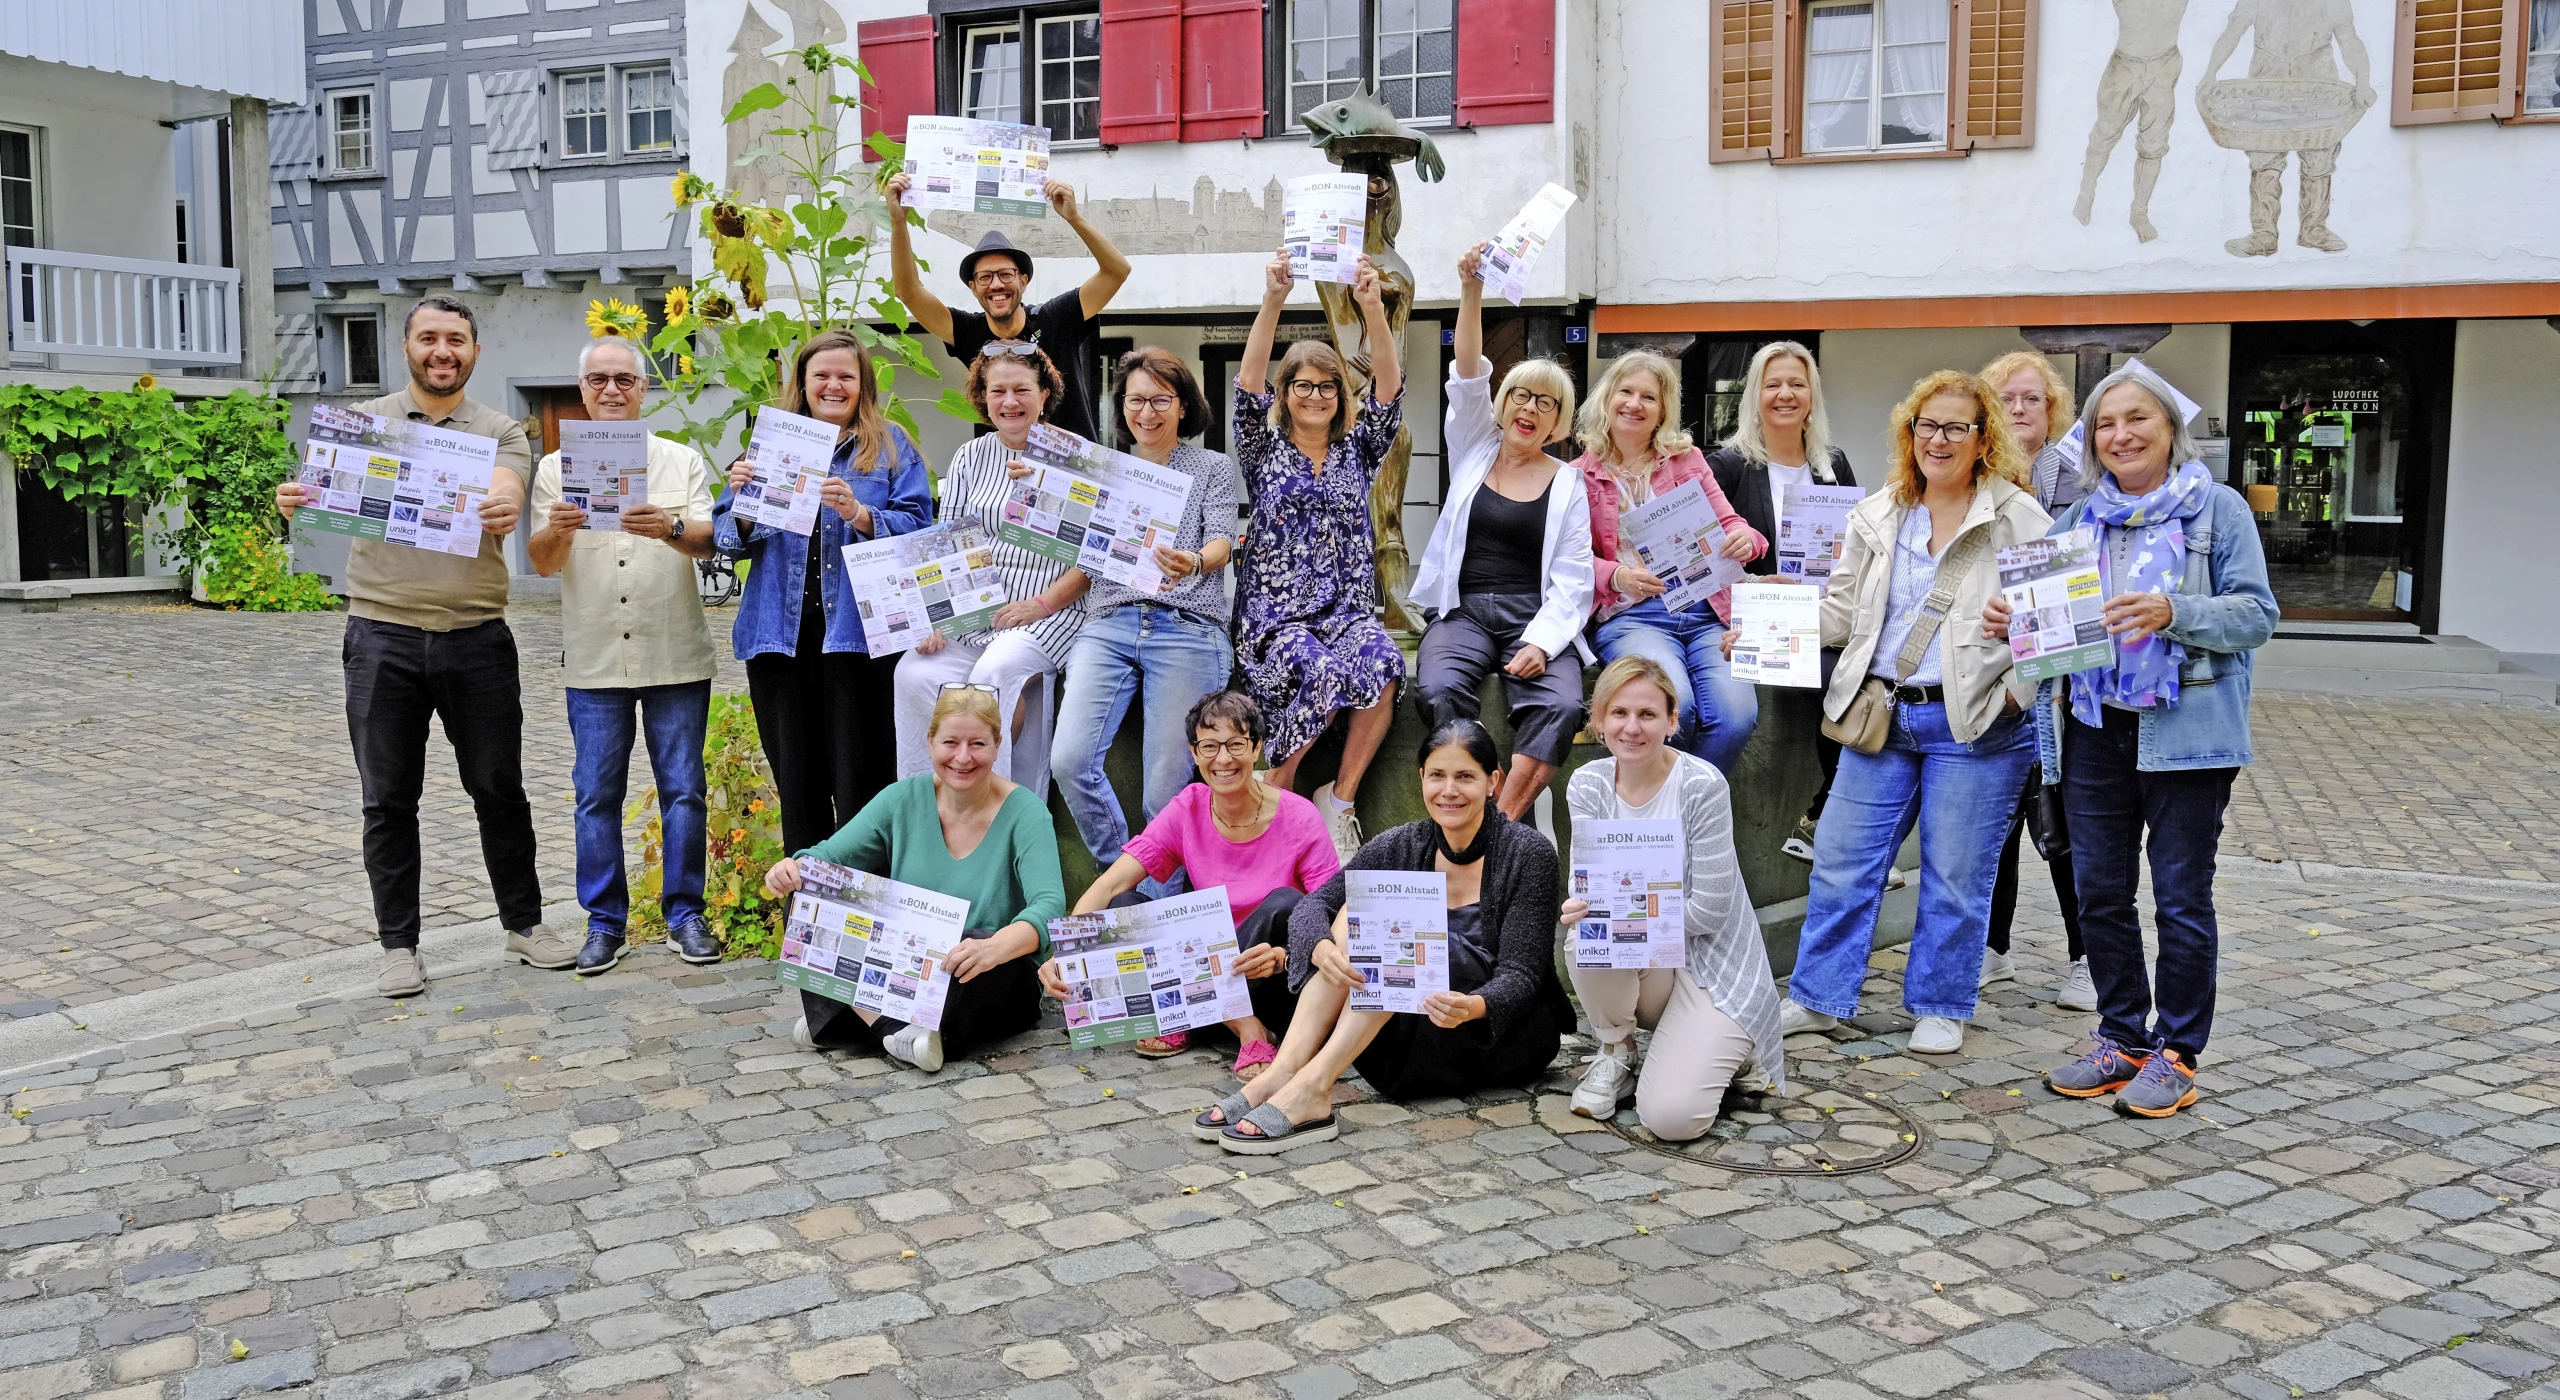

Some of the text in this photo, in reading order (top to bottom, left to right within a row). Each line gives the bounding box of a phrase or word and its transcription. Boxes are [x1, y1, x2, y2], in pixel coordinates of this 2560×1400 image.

[1304, 182, 1331, 191] arBON
[1448, 332, 1454, 343] 3
[1573, 328, 1580, 341] 5
[2333, 390, 2379, 399] LUDOTHEK
[774, 422, 831, 441] arBON Altstadt
[425, 438, 489, 456] arBON Altstadt
[2061, 440, 2082, 457] unika
[1125, 469, 1184, 494] arBON Altstadt
[735, 500, 759, 511] unikat
[1644, 491, 1699, 524] arBON Altstadt
[390, 525, 417, 536] unikat
[850, 548, 895, 562] arBON Altstadt
[1081, 552, 1106, 565] unikat
[1666, 590, 1690, 607] unikat
[1597, 833, 1674, 844] arBON Altstadt
[1368, 884, 1439, 894] arBON Altstadt
[899, 897, 960, 920] arBON Altstadt
[1157, 900, 1222, 921] arBON Altstadt
[1578, 947, 1610, 955] unikat
[858, 989, 883, 1002] unikat
[1352, 990, 1381, 998] unikat
[1160, 1010, 1187, 1024] unikat
